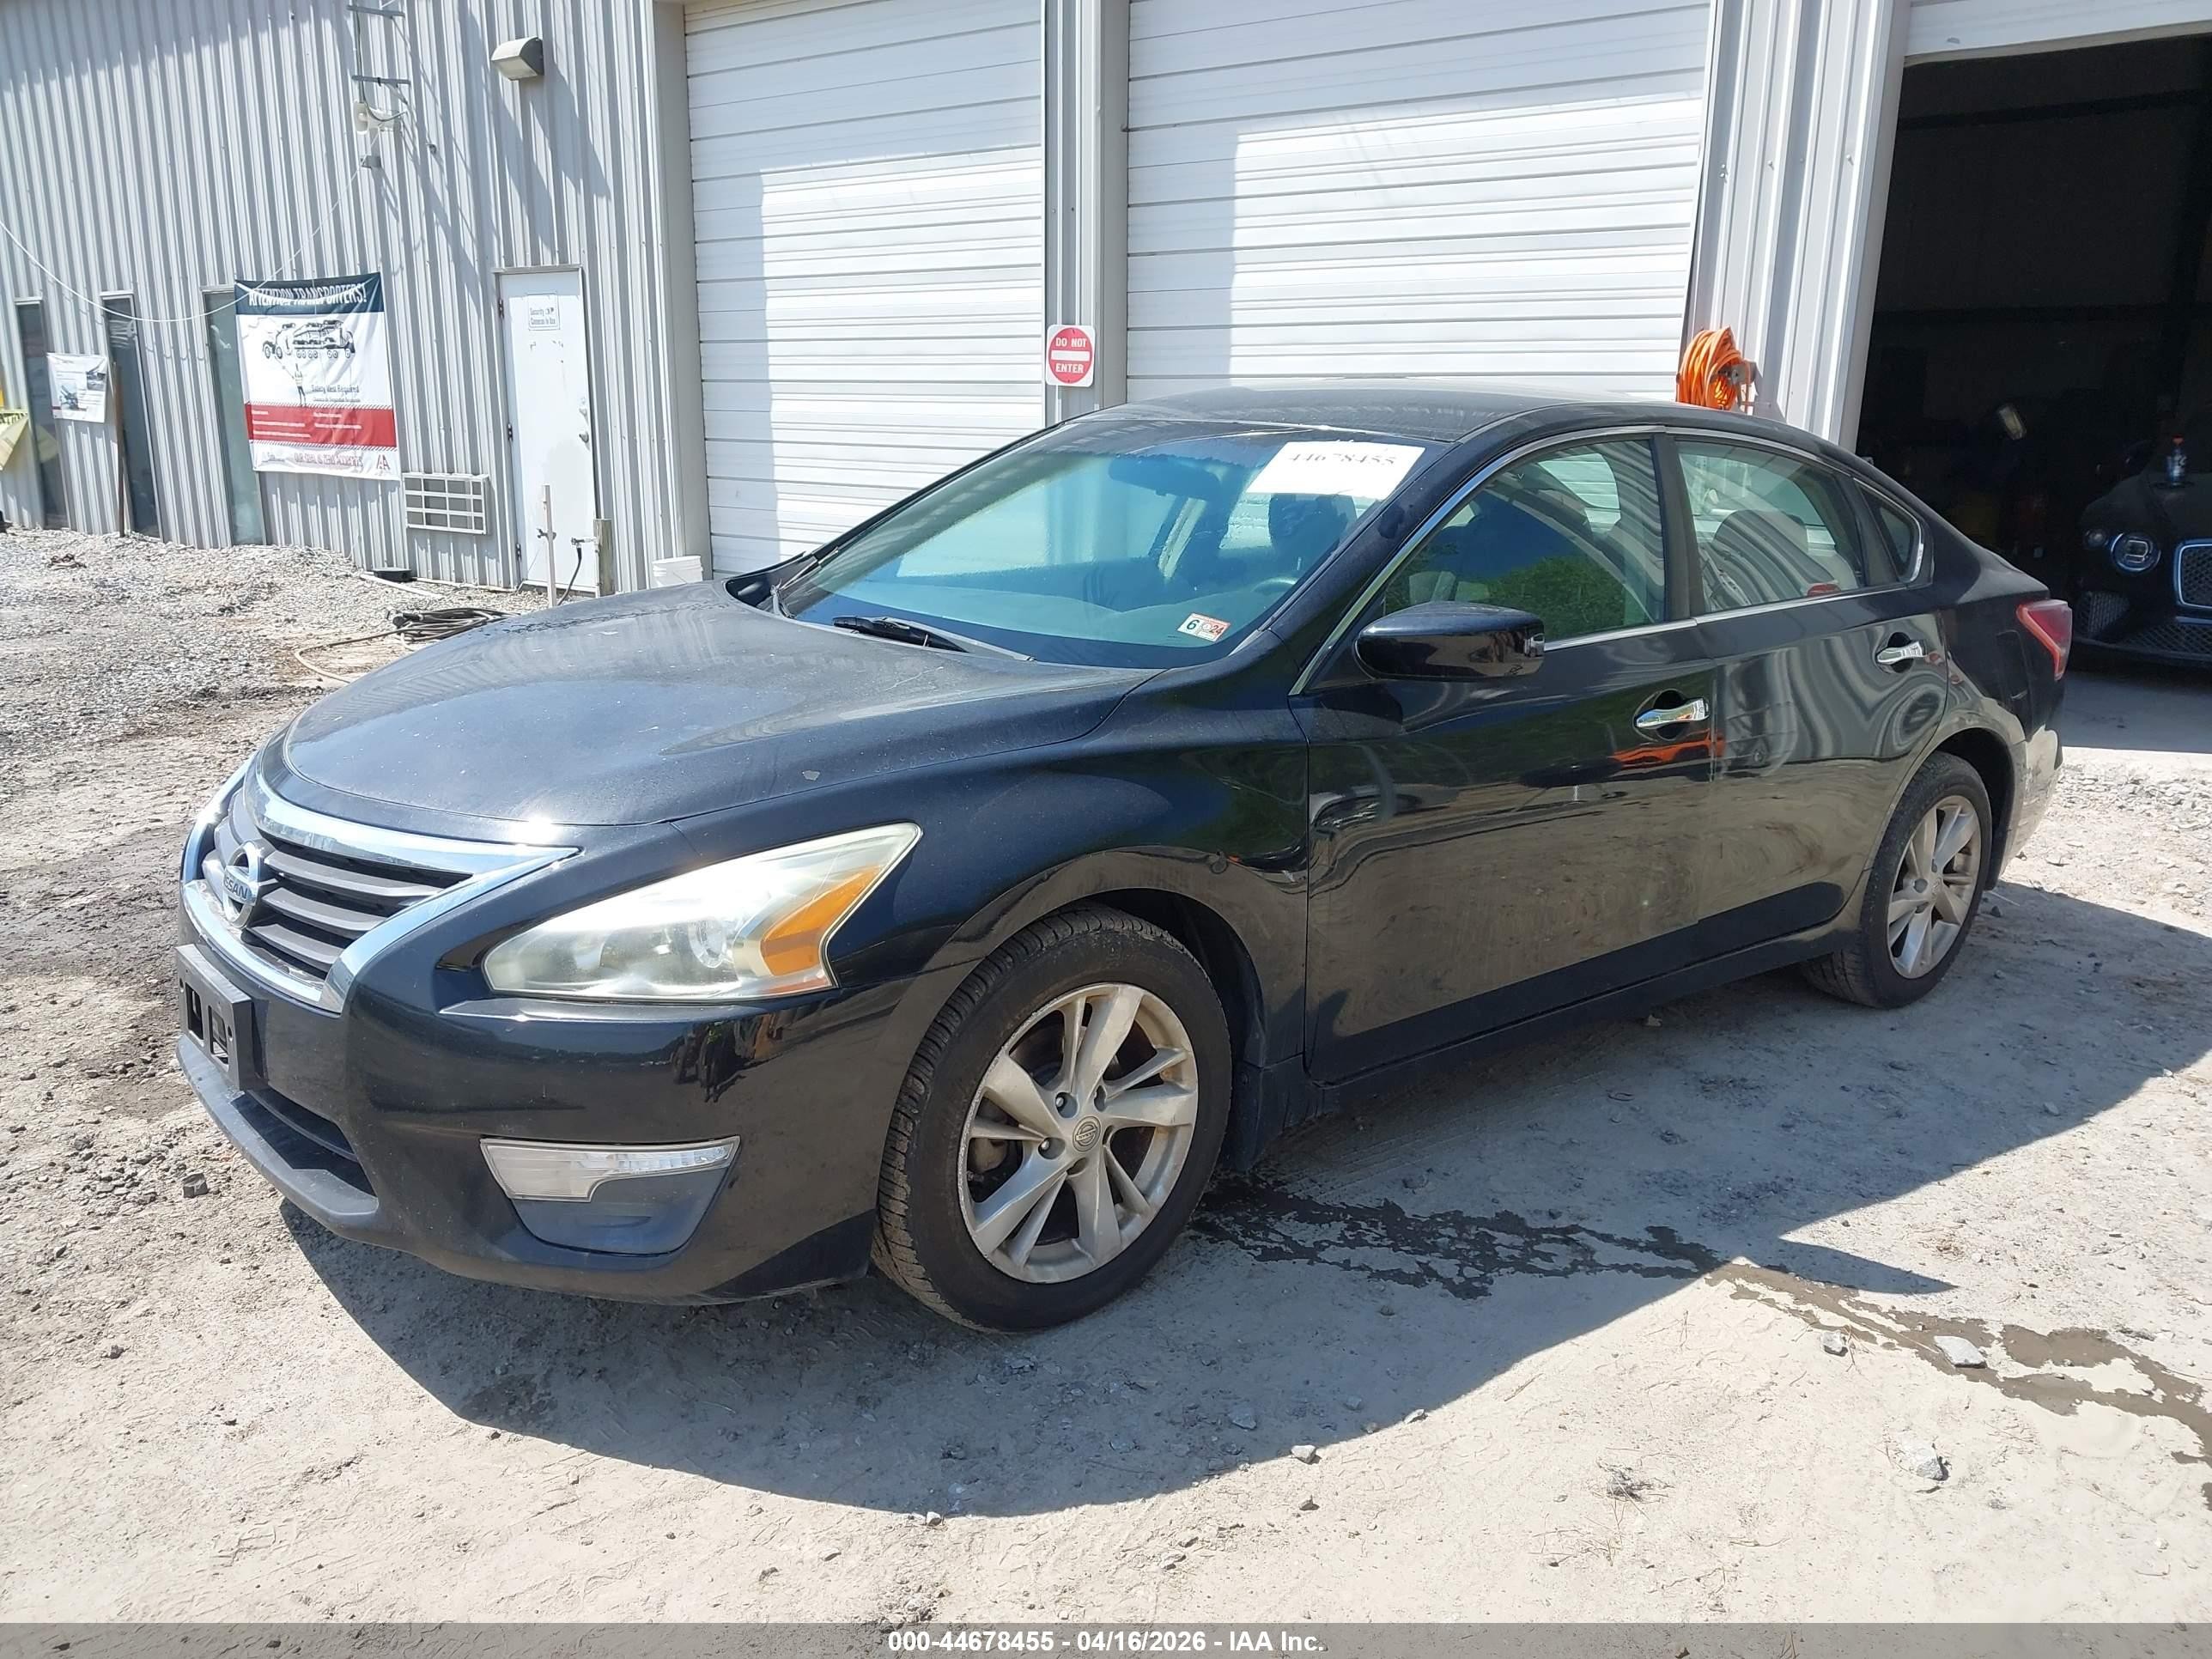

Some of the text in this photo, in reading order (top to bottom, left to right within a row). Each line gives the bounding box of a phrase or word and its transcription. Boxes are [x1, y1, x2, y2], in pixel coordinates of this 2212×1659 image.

[1055, 337, 1087, 348] DO NOT
[1055, 363, 1084, 374] ENTER
[1187, 620, 1200, 629] 6
[1209, 625, 1224, 635] 24
